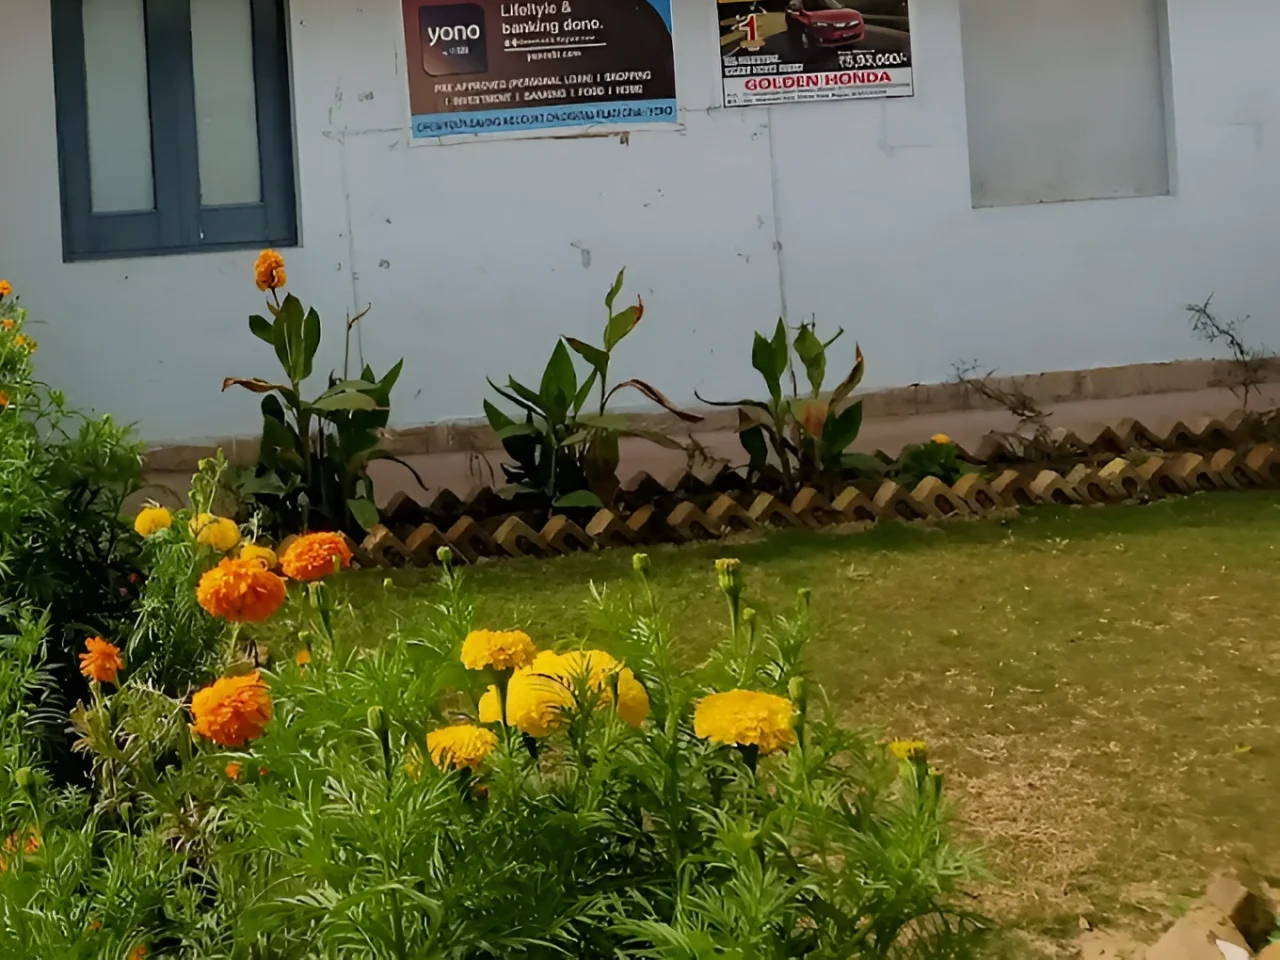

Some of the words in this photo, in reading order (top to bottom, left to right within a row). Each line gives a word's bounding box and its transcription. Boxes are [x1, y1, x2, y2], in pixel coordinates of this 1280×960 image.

[427, 24, 480, 47] yono
[744, 74, 820, 92] GOLDEN
[825, 70, 893, 87] HONDA
